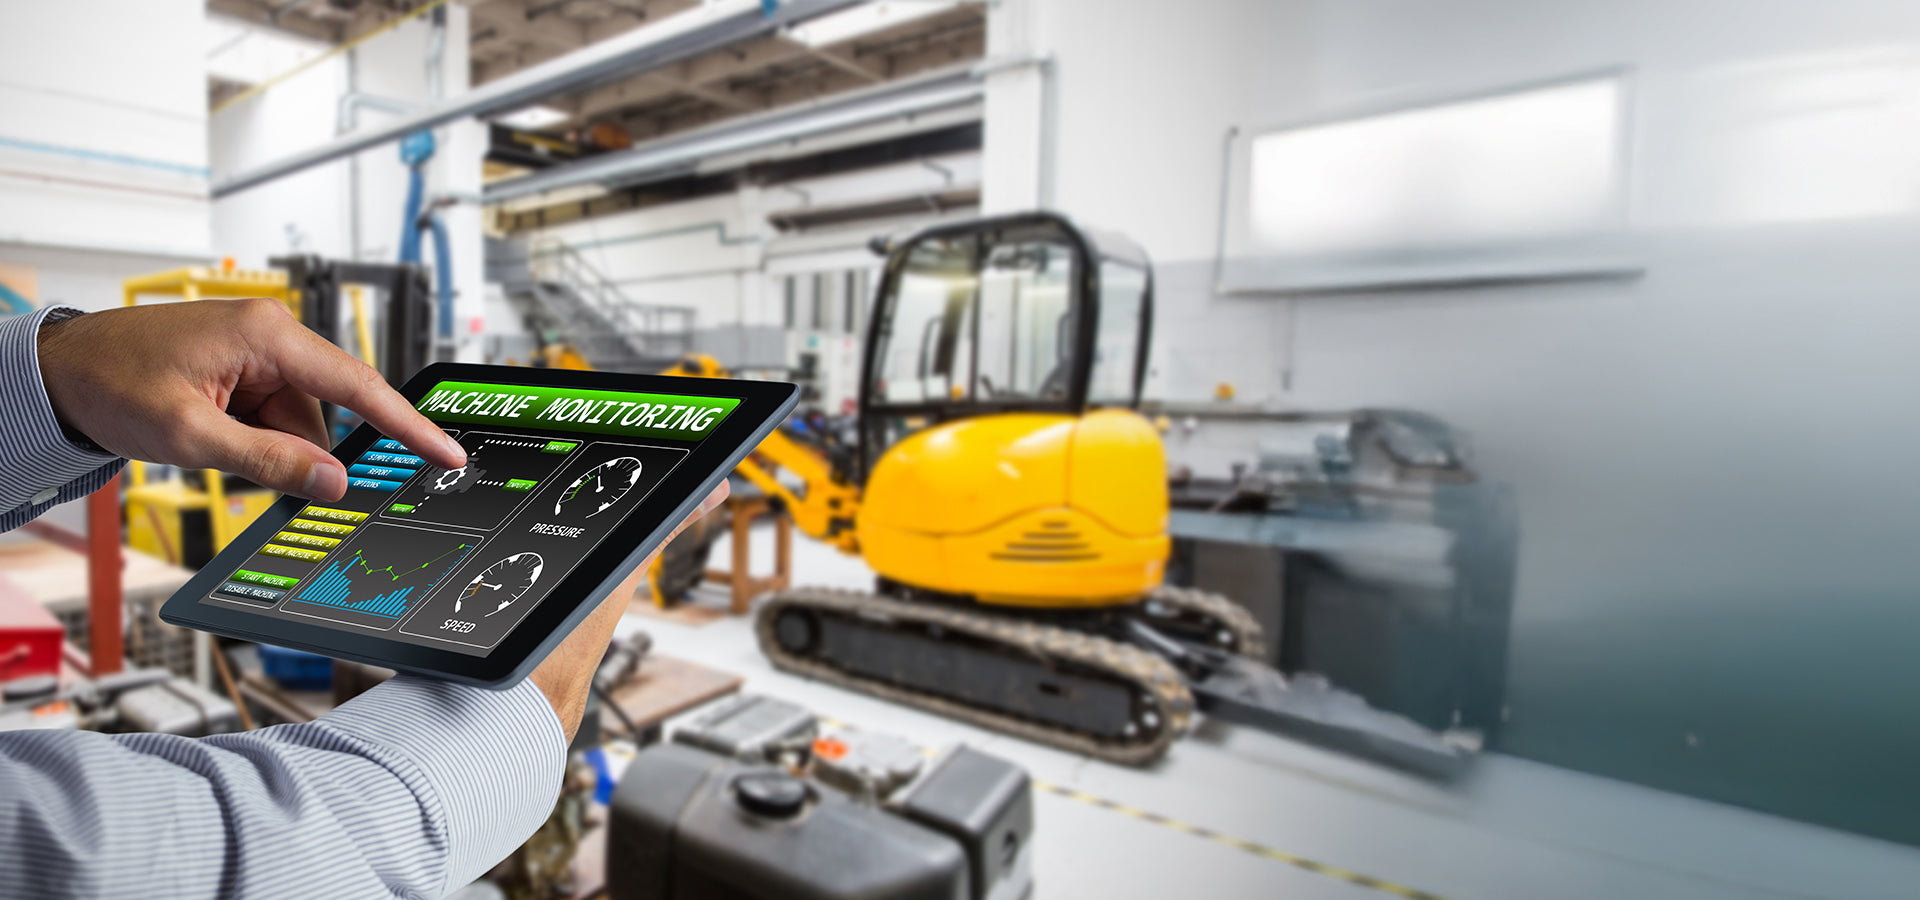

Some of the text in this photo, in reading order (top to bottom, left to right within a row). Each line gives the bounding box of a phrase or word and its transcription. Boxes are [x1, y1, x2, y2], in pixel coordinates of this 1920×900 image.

[418, 389, 725, 432] MACHINE MONITORING
[368, 454, 419, 464] SIMPLE MACHINE
[367, 468, 392, 476] REPORT
[353, 480, 380, 488] OPTIONS
[306, 508, 328, 518] ALARM
[326, 511, 352, 520] MACHINE
[293, 521, 314, 530] ALARM
[313, 524, 339, 534] MACHINE
[529, 522, 586, 539] PRESSURE
[279, 533, 301, 542] ALARM
[299, 536, 326, 546] MACHINE
[266, 546, 287, 555] ALARM
[286, 548, 312, 559] MACHINE
[241, 572, 288, 586] START MACHINE
[224, 584, 278, 600] DISABLE MACHINE
[440, 619, 476, 634] SPEED
